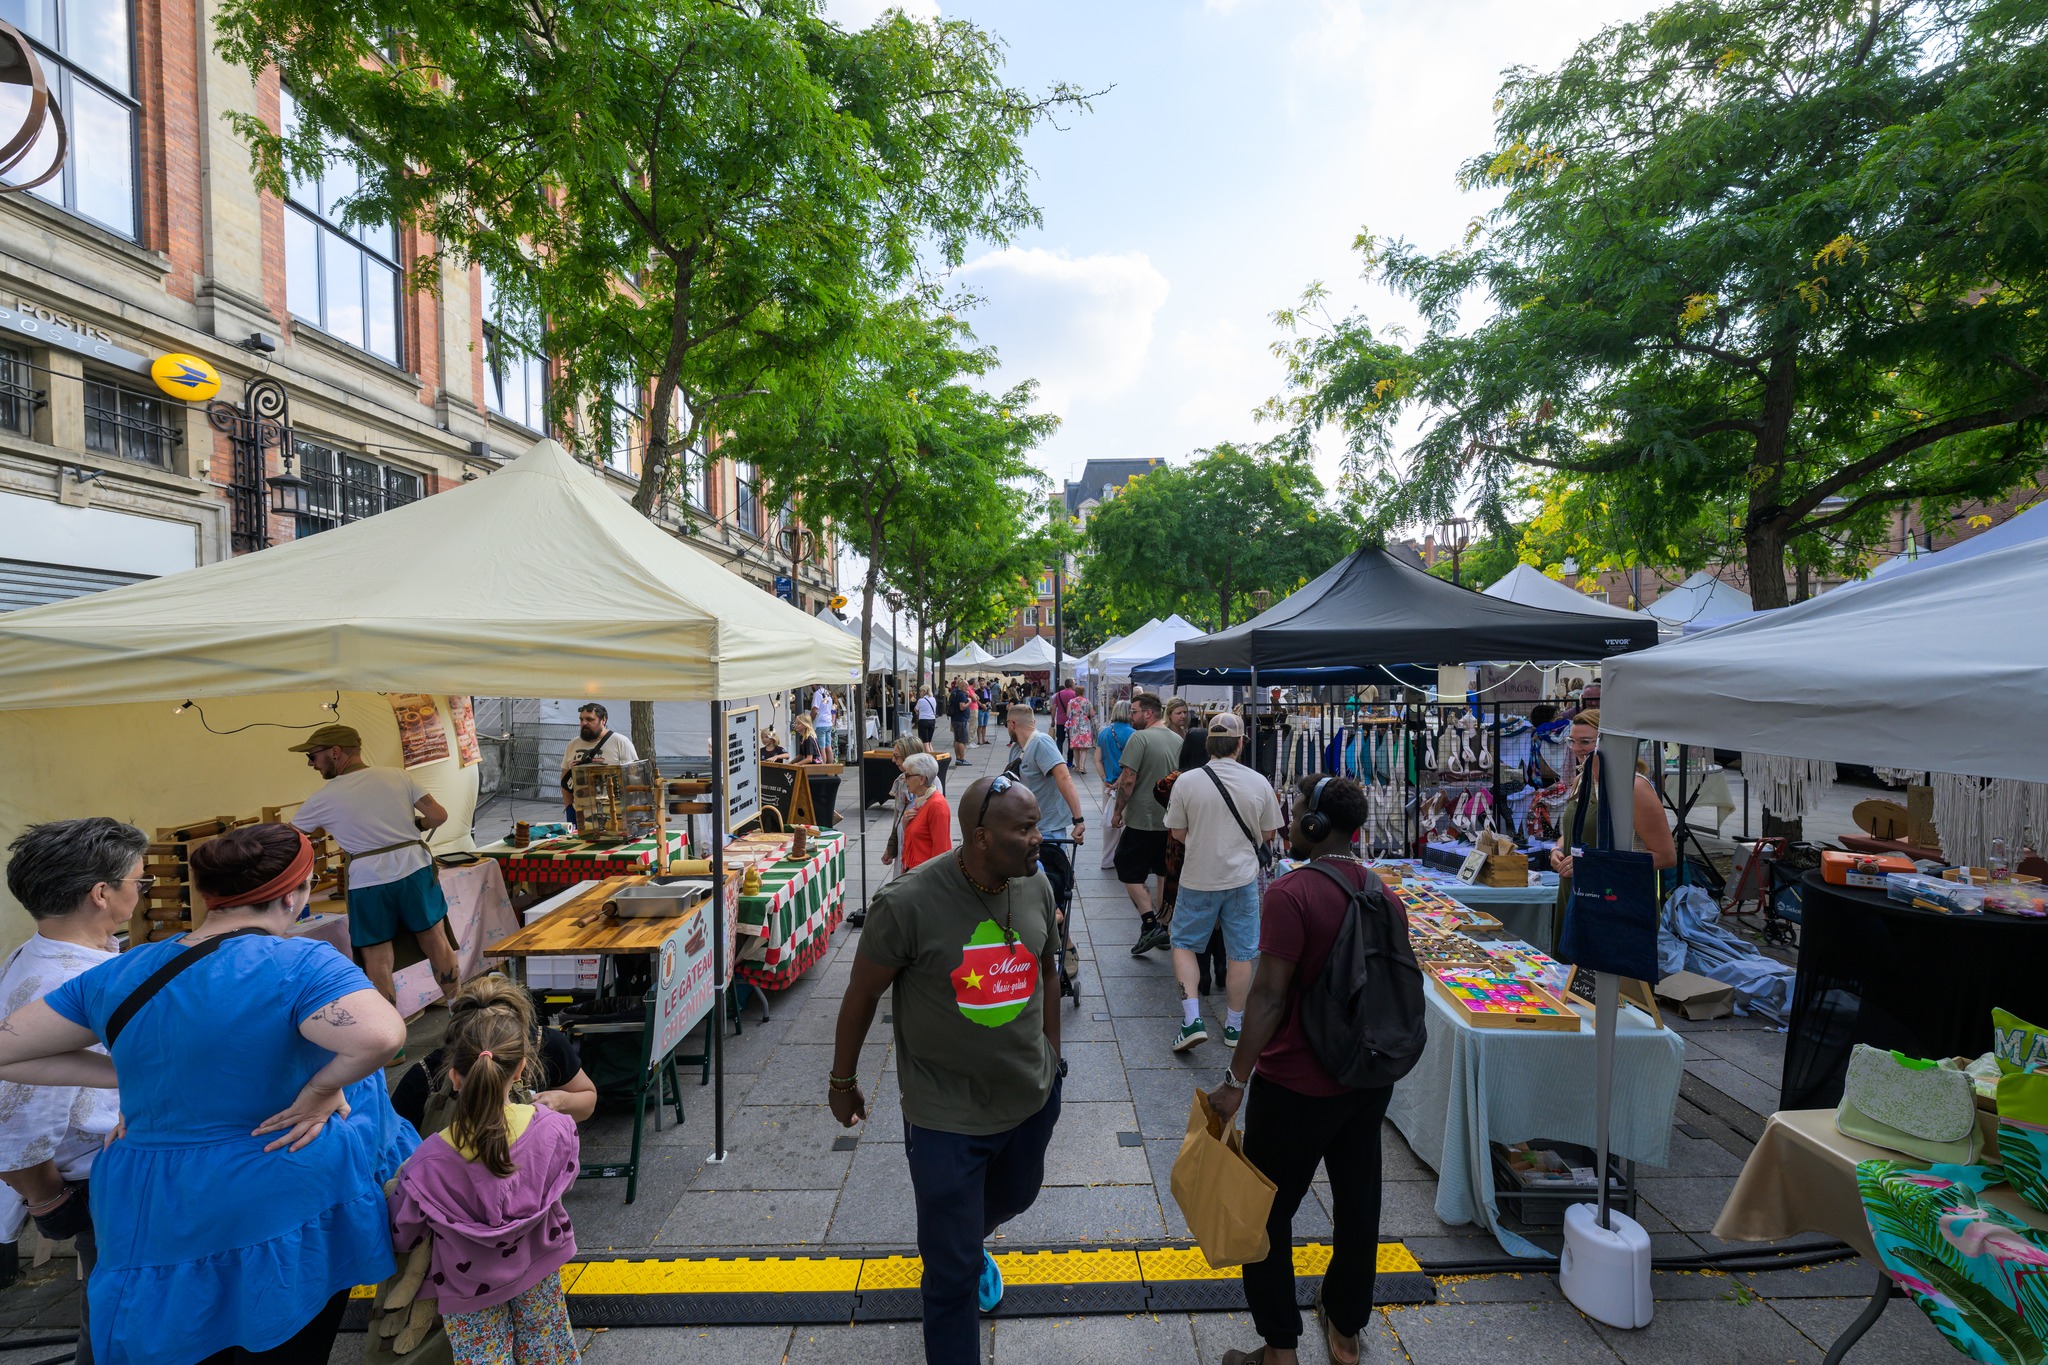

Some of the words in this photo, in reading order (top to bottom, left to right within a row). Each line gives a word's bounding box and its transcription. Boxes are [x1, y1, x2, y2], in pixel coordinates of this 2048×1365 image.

[17, 299, 112, 345] POSTES
[664, 988, 678, 1019] LE
[679, 948, 713, 1001] GÂTEAU
[989, 957, 1031, 975] Moun
[661, 973, 714, 1051] CHEMINÉ
